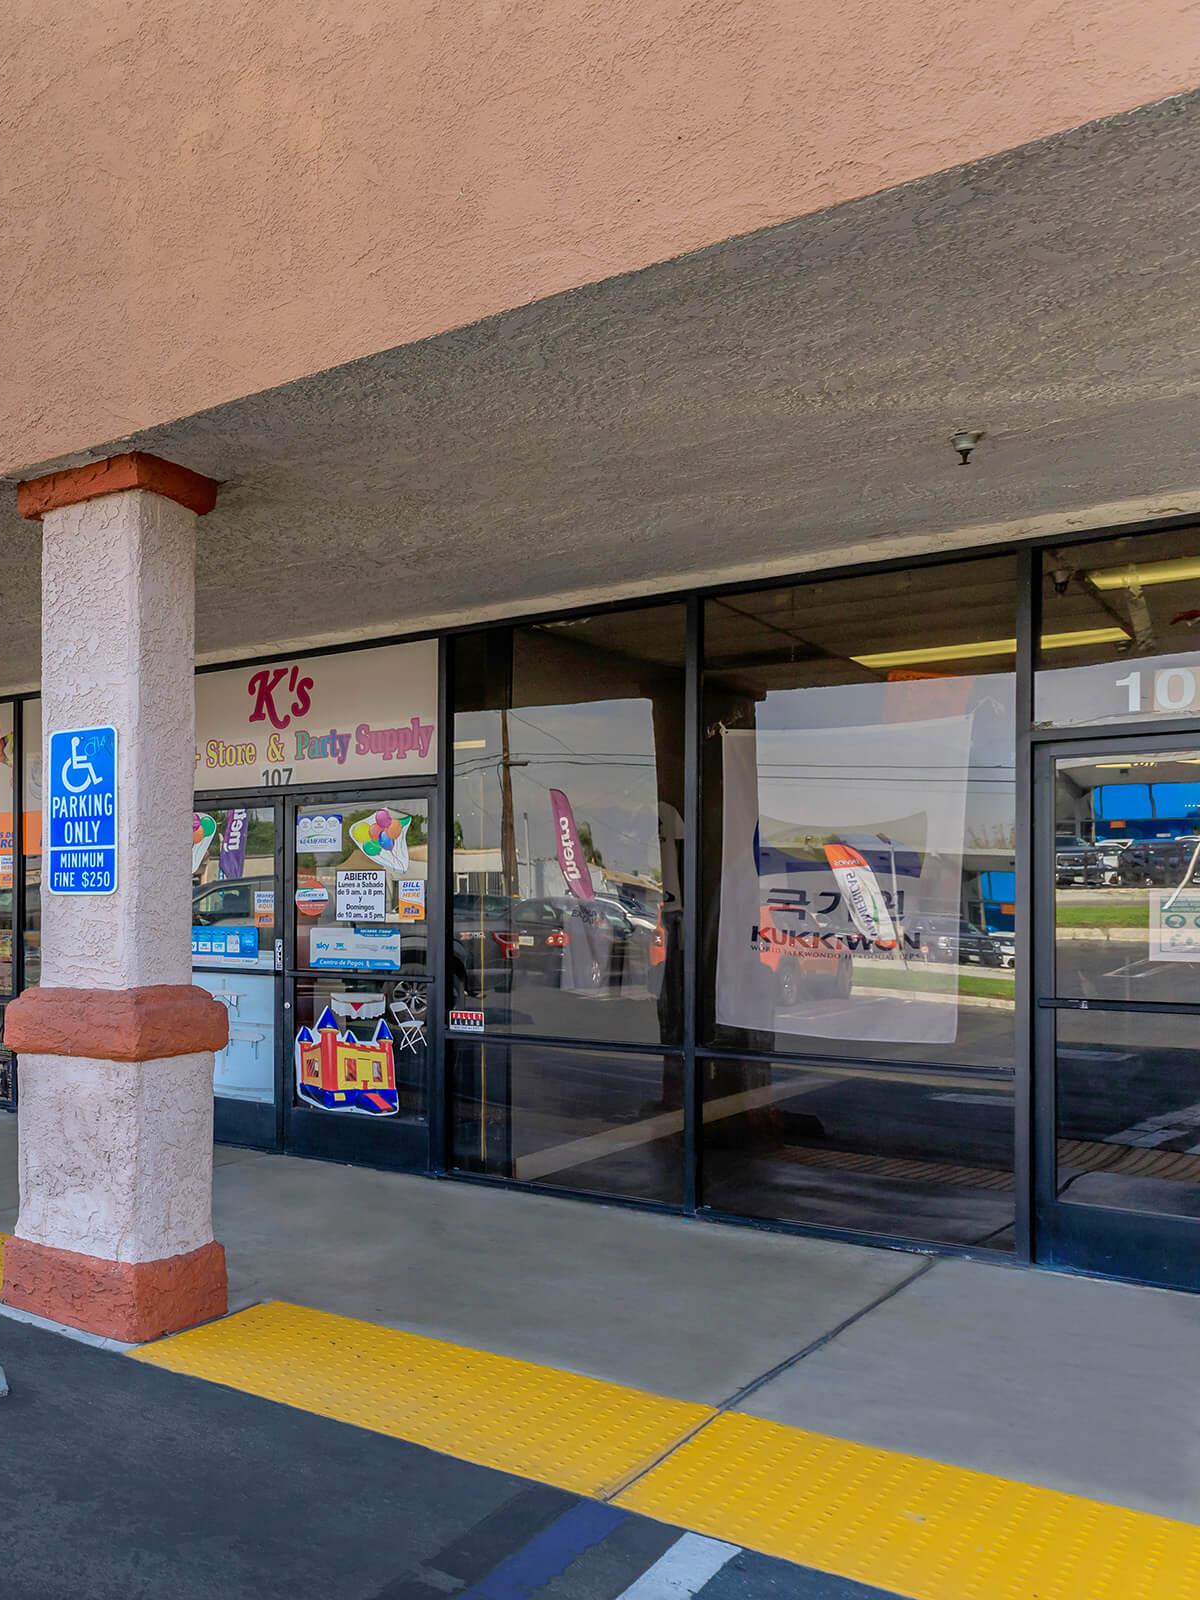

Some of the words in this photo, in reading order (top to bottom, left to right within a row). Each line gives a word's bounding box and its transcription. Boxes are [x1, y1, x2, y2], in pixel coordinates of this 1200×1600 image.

[247, 665, 314, 730] K's
[205, 739, 258, 768] Store
[266, 733, 286, 763] &
[294, 729, 353, 765] Party
[355, 717, 435, 760] Supply
[262, 767, 295, 786] 107
[52, 793, 113, 819] PARKING
[64, 820, 101, 844] ONLY
[60, 852, 104, 868] MINIMUM
[53, 871, 76, 888] FINE
[81, 871, 111, 888] $250
[344, 872, 378, 880] ABIERTO
[316, 942, 330, 951] sky
